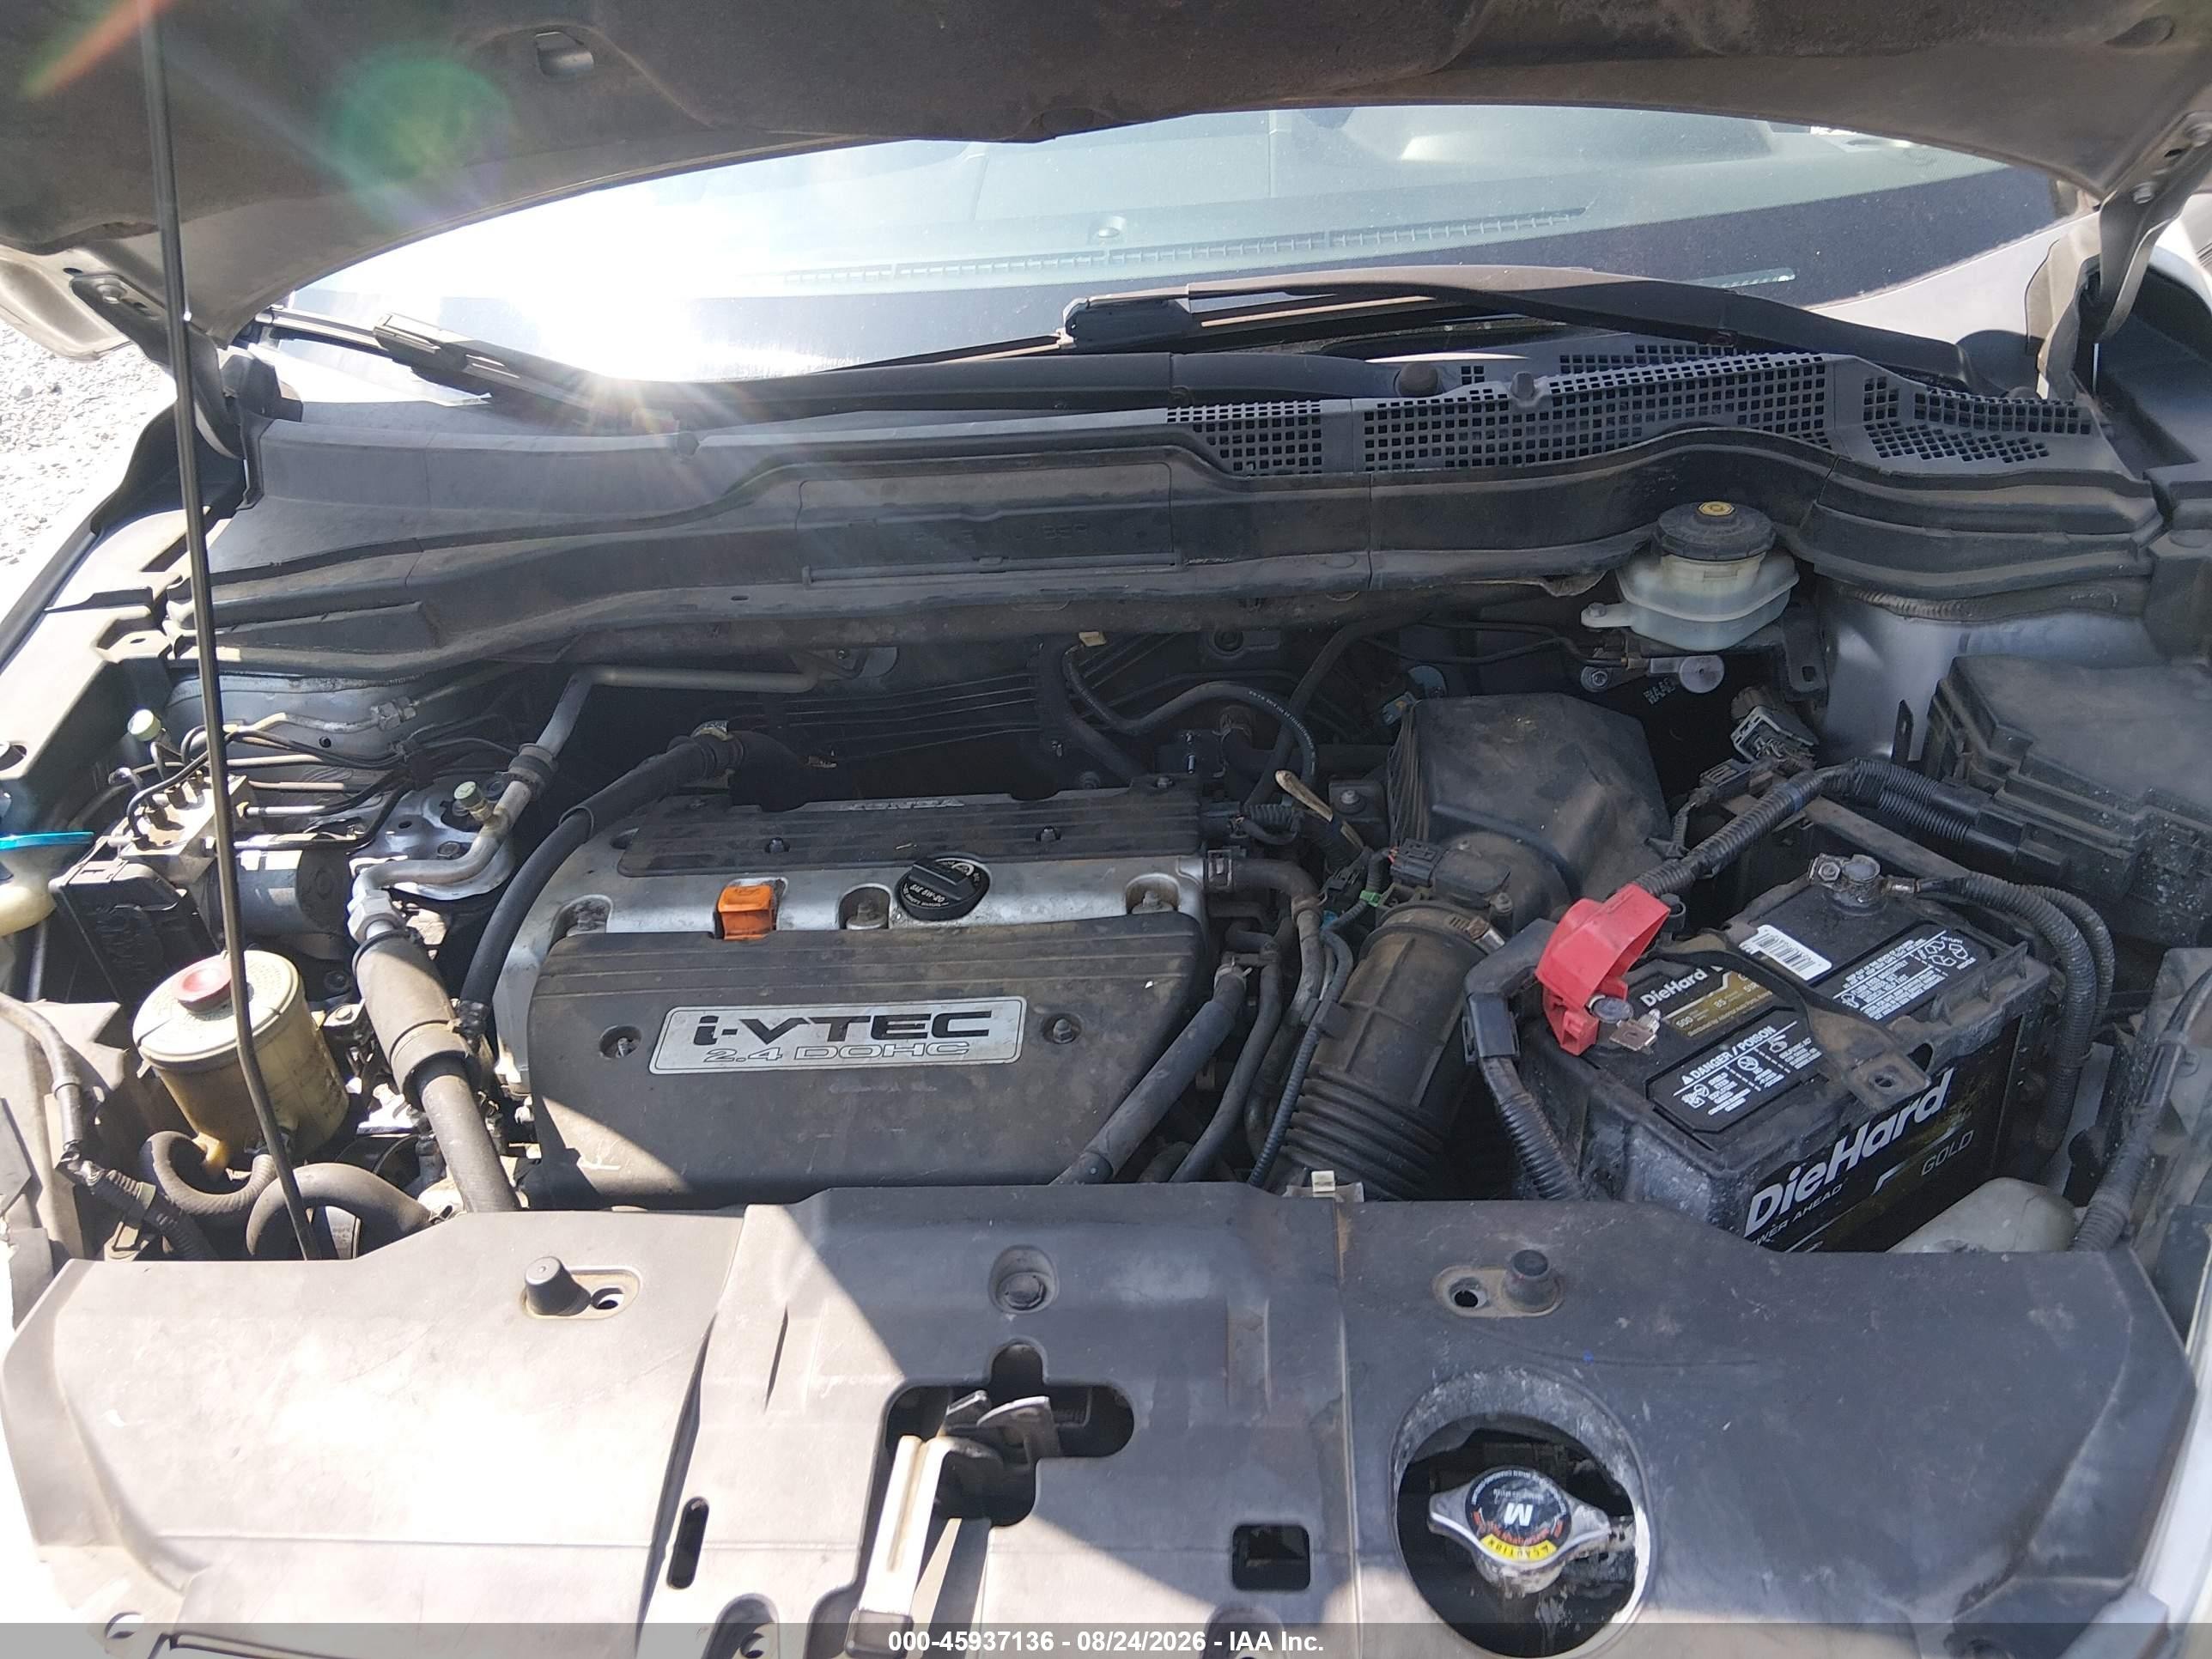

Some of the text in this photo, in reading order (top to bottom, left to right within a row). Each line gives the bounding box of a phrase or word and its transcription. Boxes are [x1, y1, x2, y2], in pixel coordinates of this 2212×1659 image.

[1640, 969, 1708, 1007] DieHard
[693, 1011, 993, 1047] i-VTEC
[703, 1041, 970, 1063] 2.4 DOHC
[1689, 1051, 1733, 1079] DANGER
[1736, 1025, 1778, 1051] POISON
[1744, 1066, 1955, 1237] DieHard
[1921, 1129, 1975, 1176] GOLD
[1792, 1182, 1844, 1223] AHEAD
[1504, 1502, 1534, 1527] M
[1487, 1540, 1540, 1558] CAUTION
